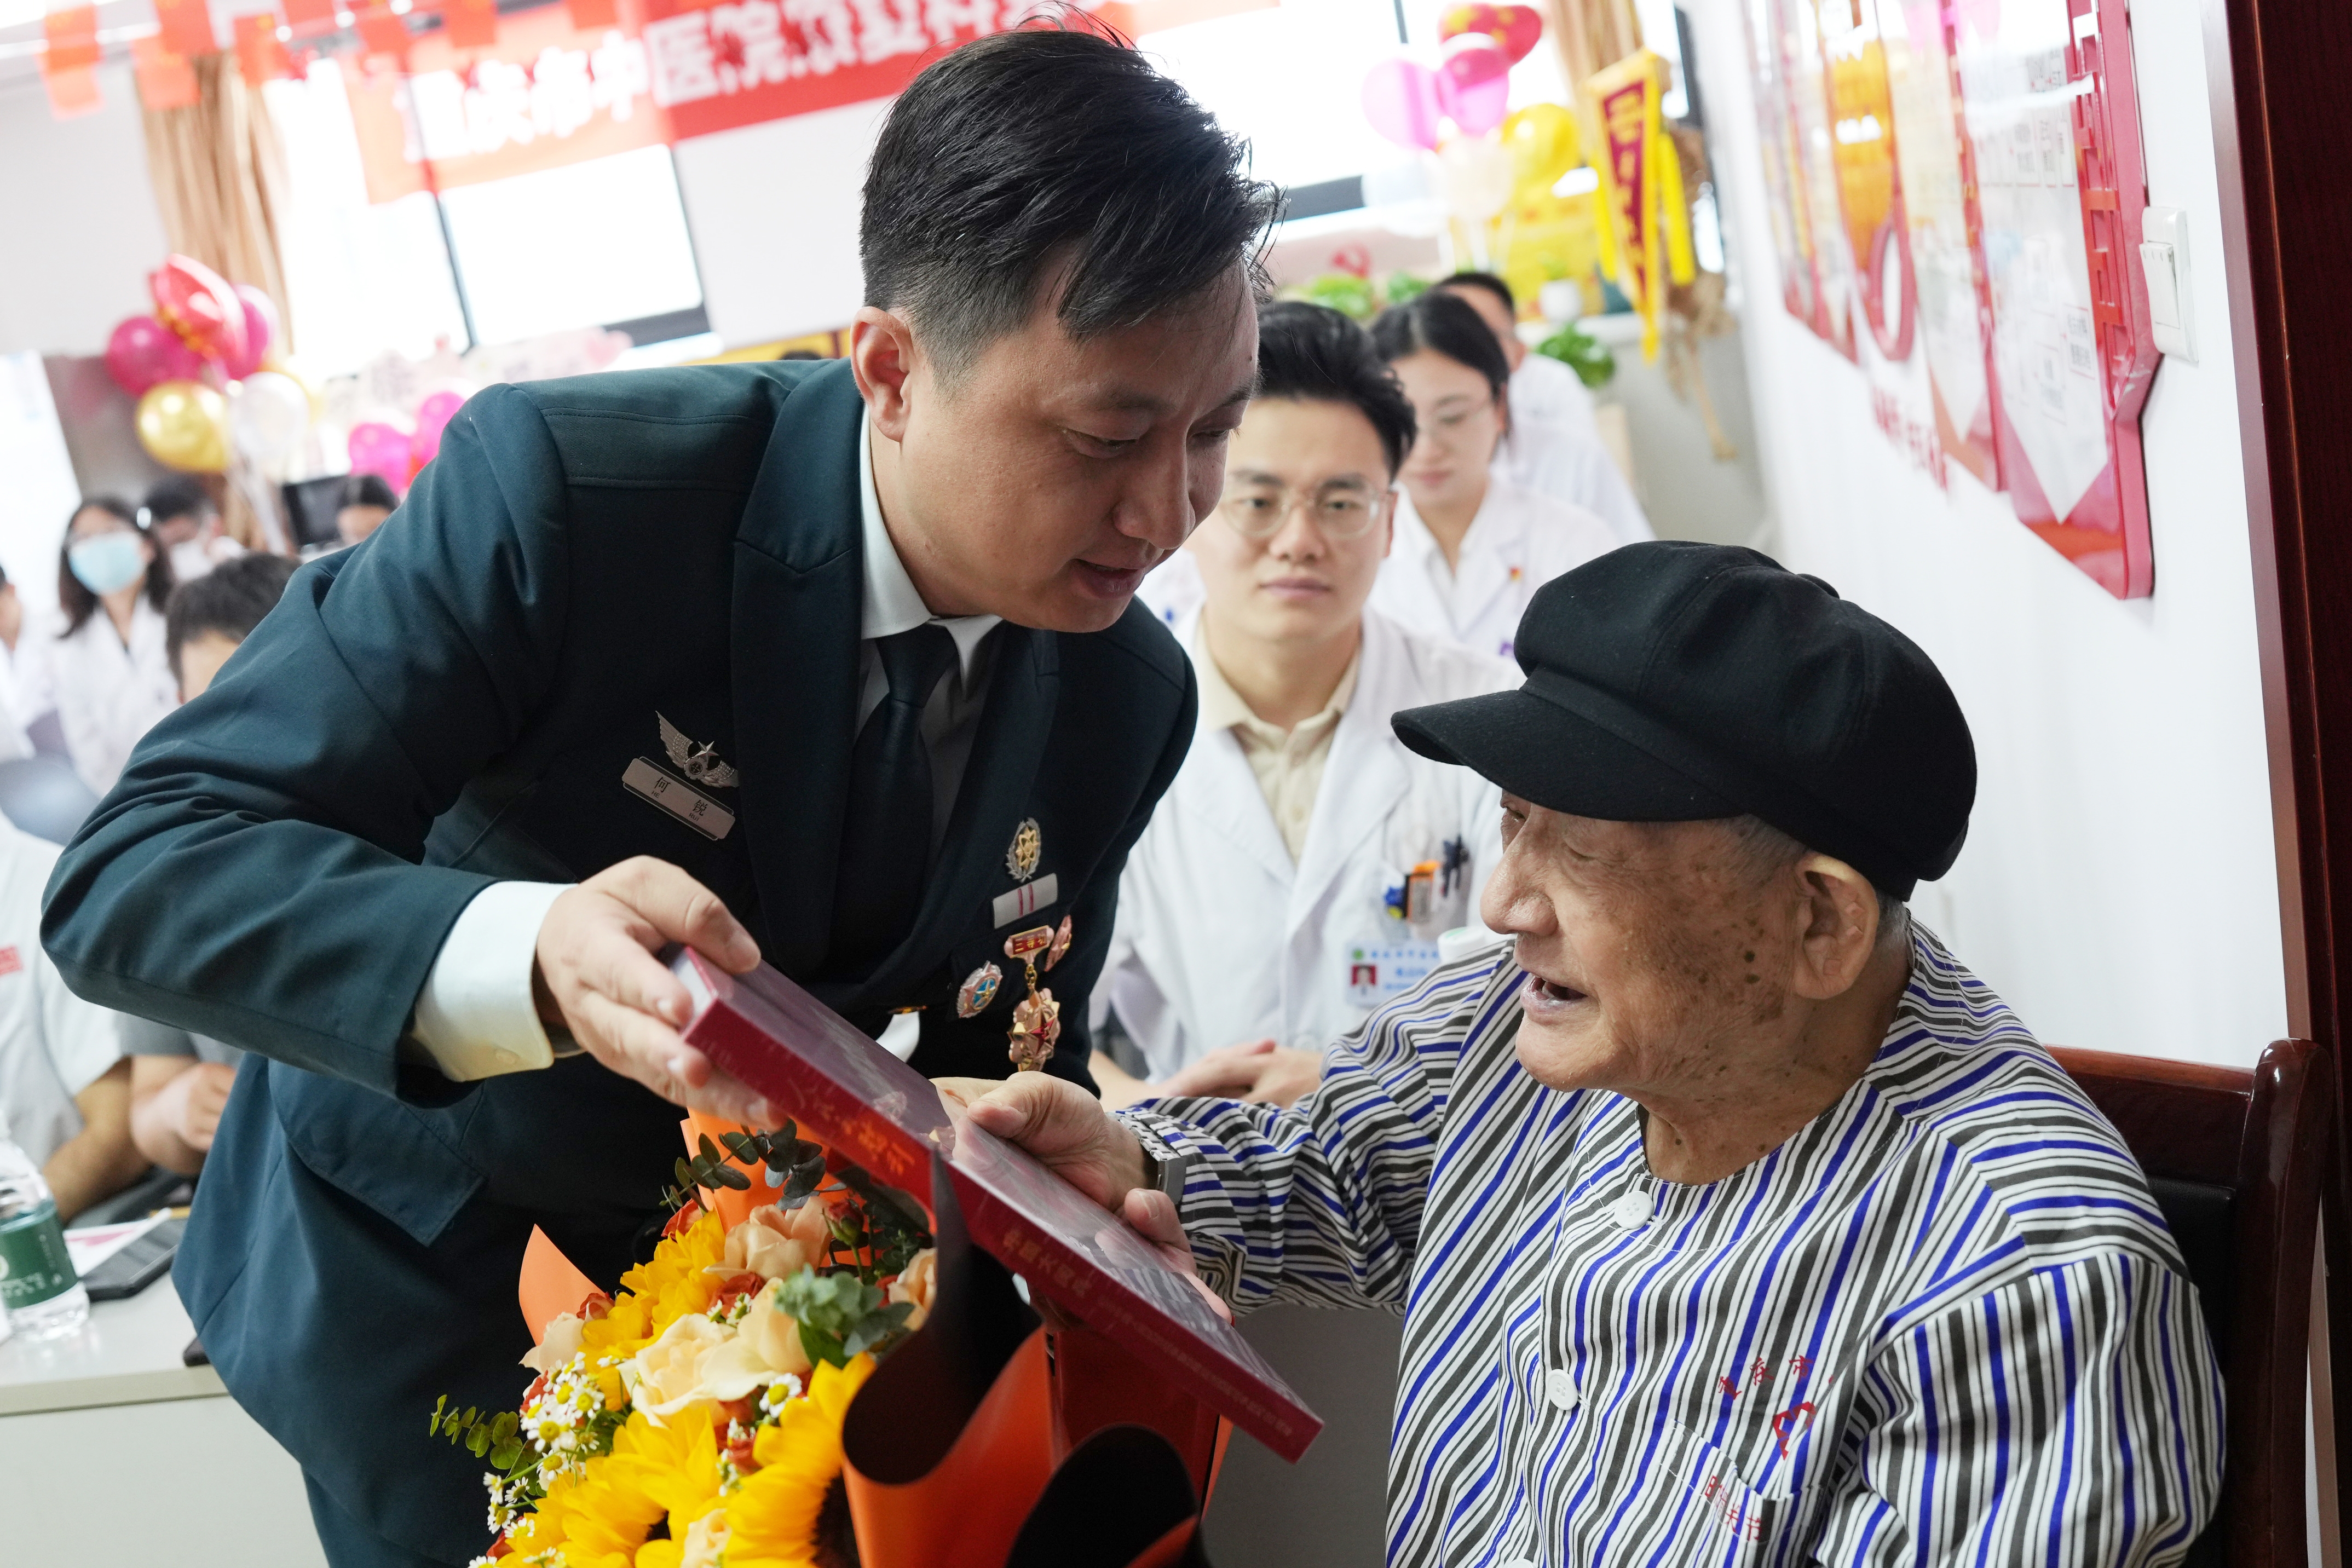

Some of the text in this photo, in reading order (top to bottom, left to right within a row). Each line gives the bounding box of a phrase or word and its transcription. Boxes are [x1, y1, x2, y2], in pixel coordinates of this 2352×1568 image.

[651, 791, 700, 822] HE RUI
[655, 776, 708, 816] 何 锐
[1718, 1354, 1834, 1400] 重庆市
